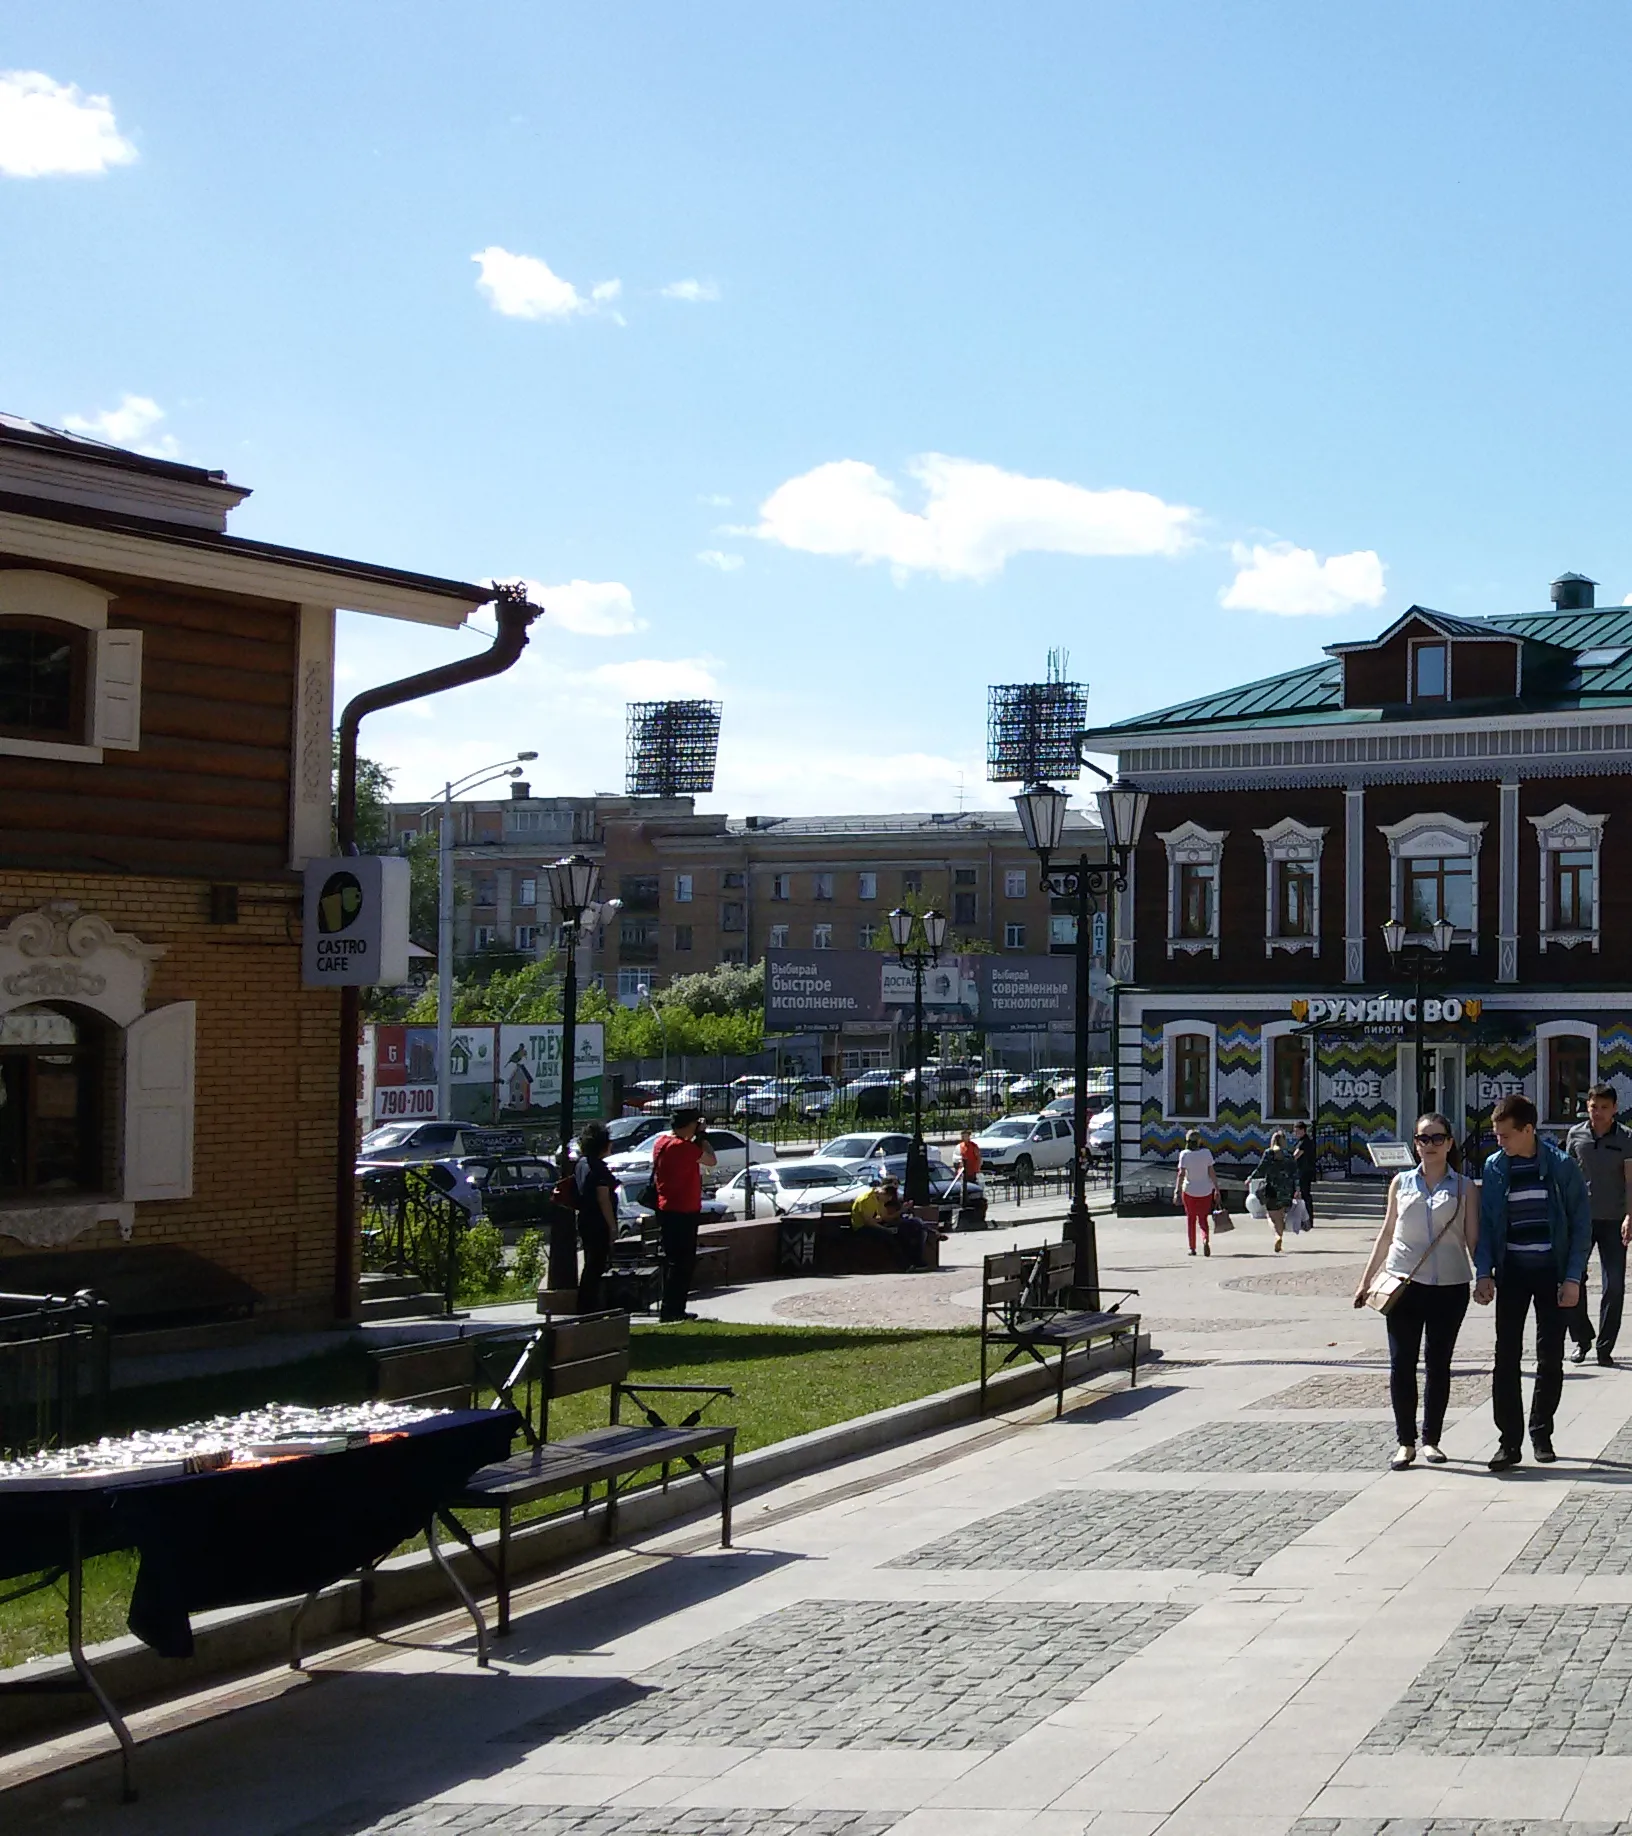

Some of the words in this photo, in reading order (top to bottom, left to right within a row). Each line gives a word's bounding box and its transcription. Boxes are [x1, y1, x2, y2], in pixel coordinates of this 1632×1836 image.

[317, 939, 367, 955] CASTRO
[316, 957, 349, 972] CAFE
[771, 962, 818, 977] Выбирай
[884, 976, 928, 988] ДОСТАВА
[992, 969, 1030, 982] Выбирай
[772, 975, 832, 995] быстрое
[992, 982, 1069, 997] современные
[772, 996, 859, 1010] исполнение.
[991, 995, 1060, 1009] технологии!
[1308, 998, 1463, 1022] РУМЯНОВО
[1364, 1025, 1404, 1034] ПИРОГИ
[1331, 1080, 1382, 1098] КАФЕ
[1479, 1081, 1524, 1099] CAFE
[381, 1089, 434, 1114] 790-700
